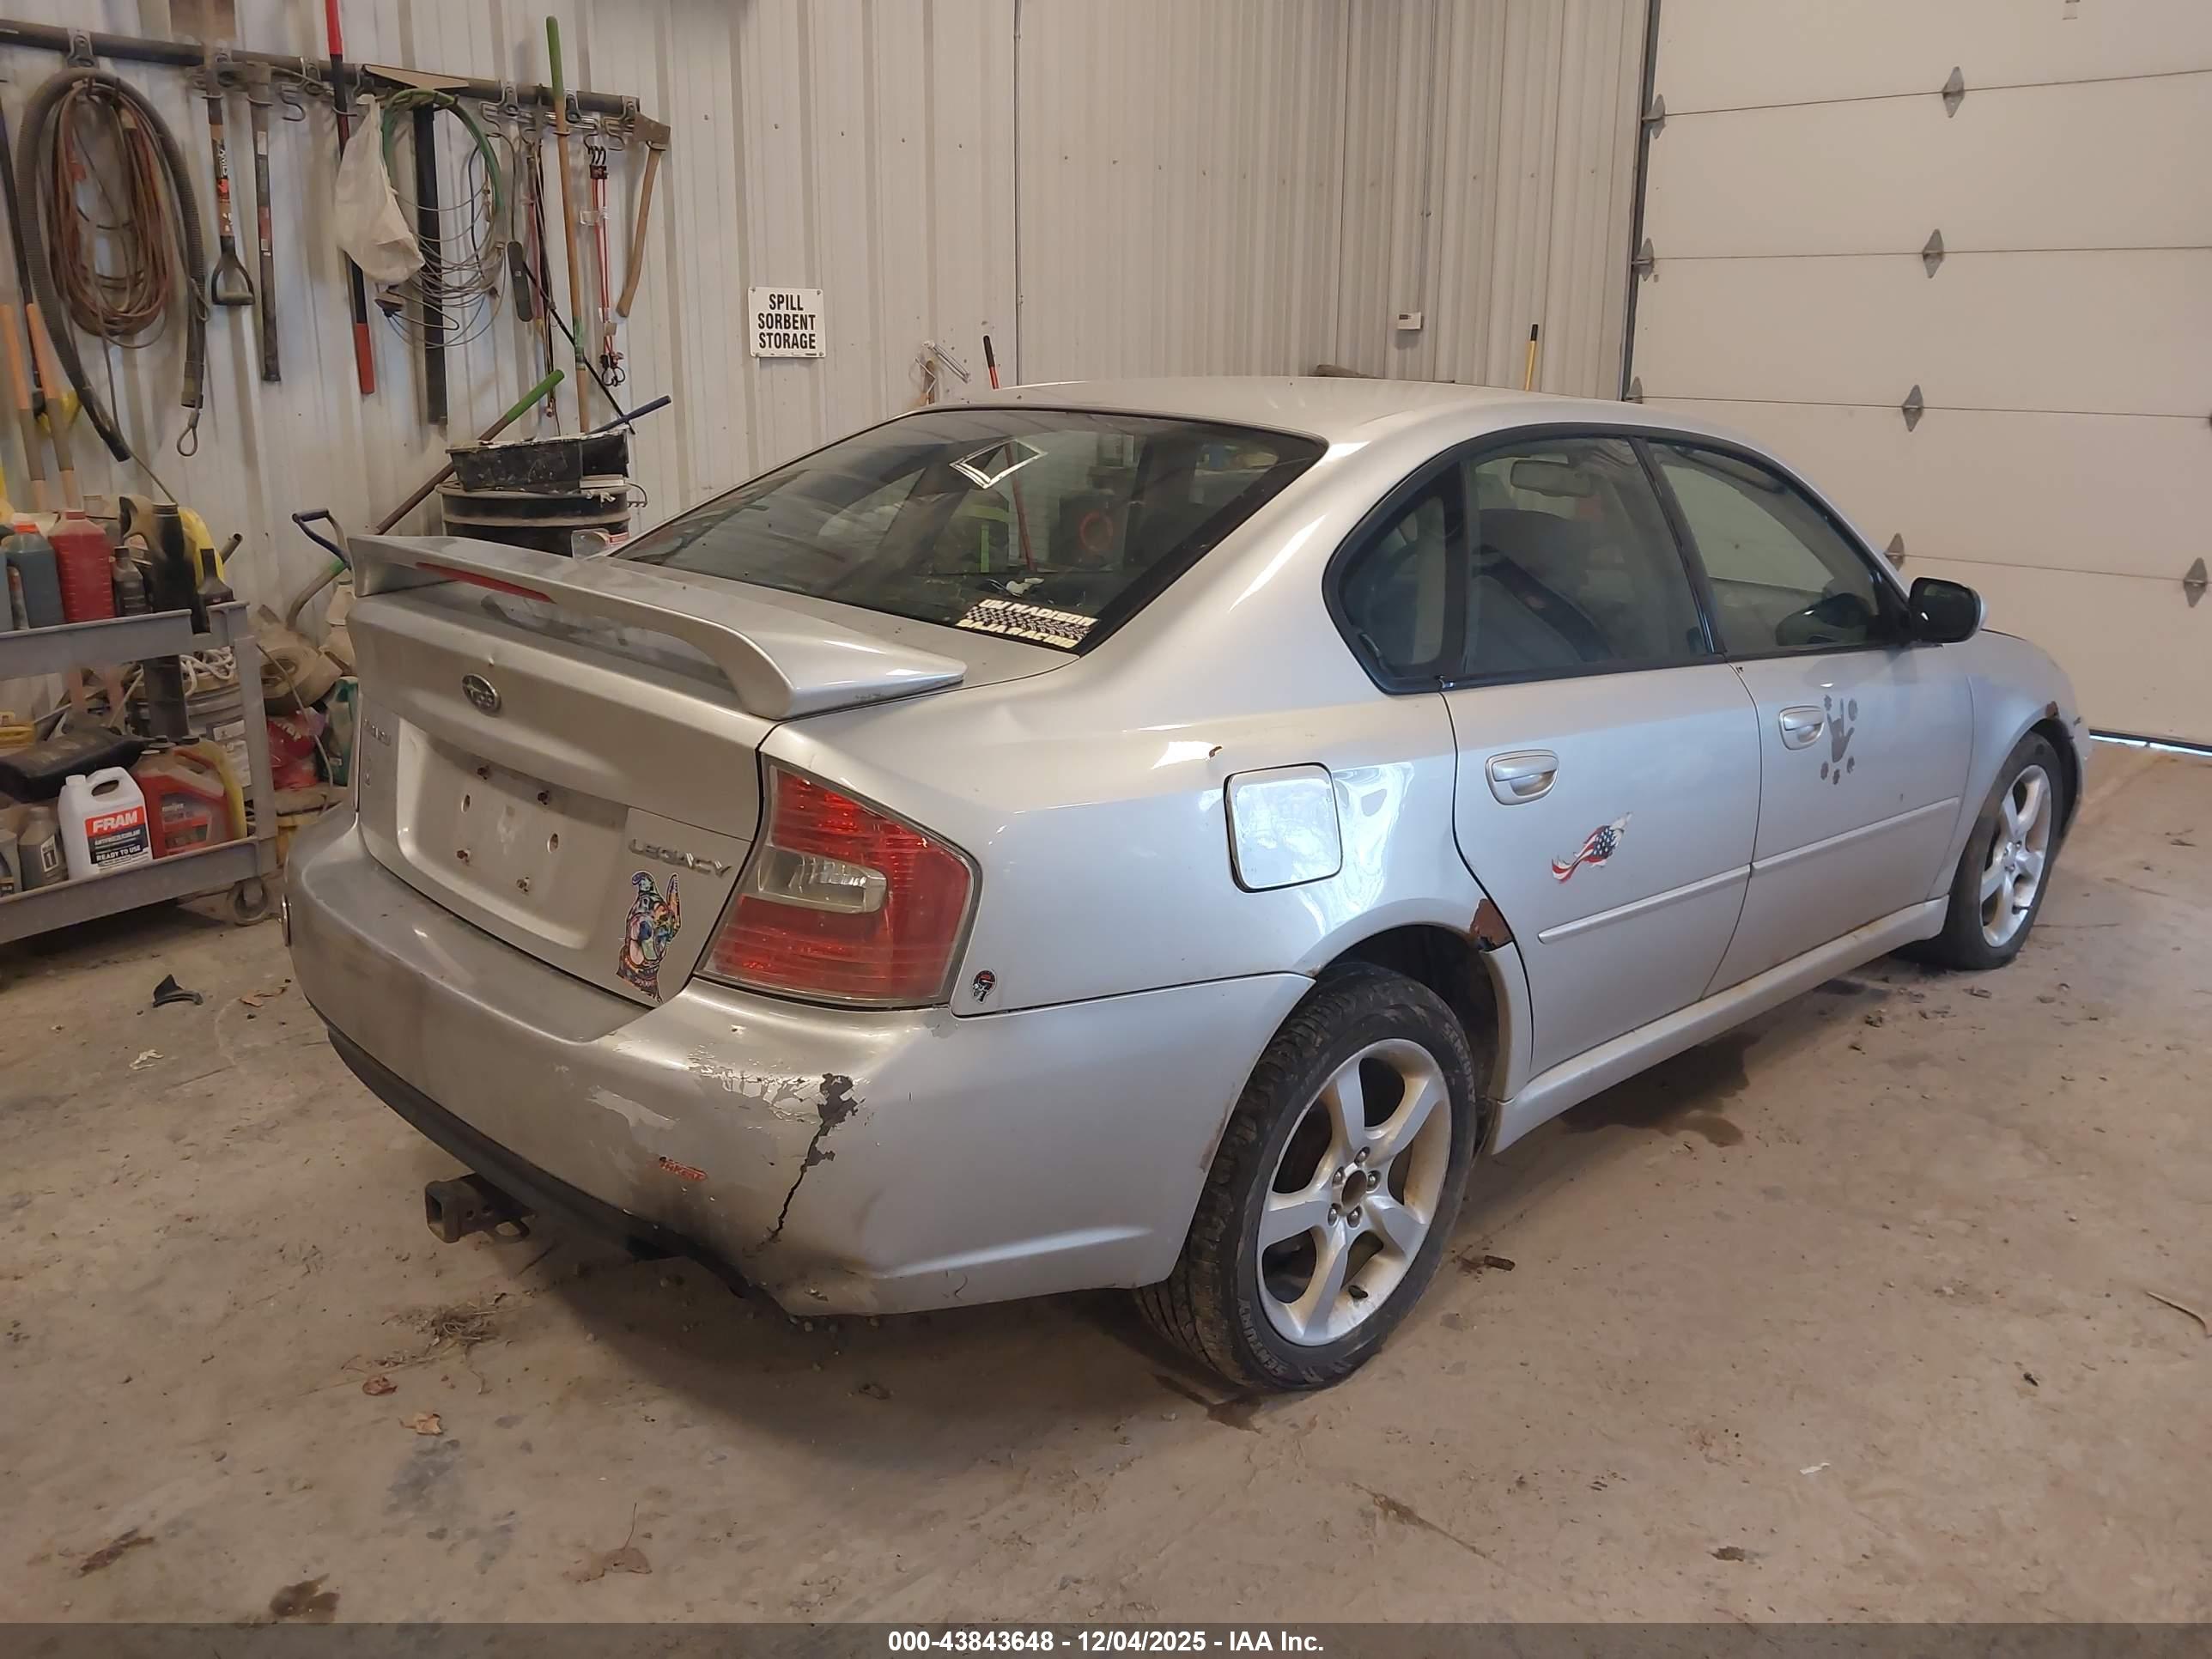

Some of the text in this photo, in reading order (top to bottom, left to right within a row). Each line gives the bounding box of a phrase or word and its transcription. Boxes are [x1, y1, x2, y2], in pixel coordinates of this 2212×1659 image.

[769, 294, 804, 311] SPILL
[757, 313, 816, 331] SORBENT
[759, 332, 816, 349] STORAGE
[1009, 603, 1099, 625] MADISON
[955, 618, 1080, 649] BAJA RACING
[93, 810, 138, 834] FRAM
[96, 851, 118, 861] READY
[129, 844, 141, 853] USE
[628, 839, 732, 878] LEGACY
